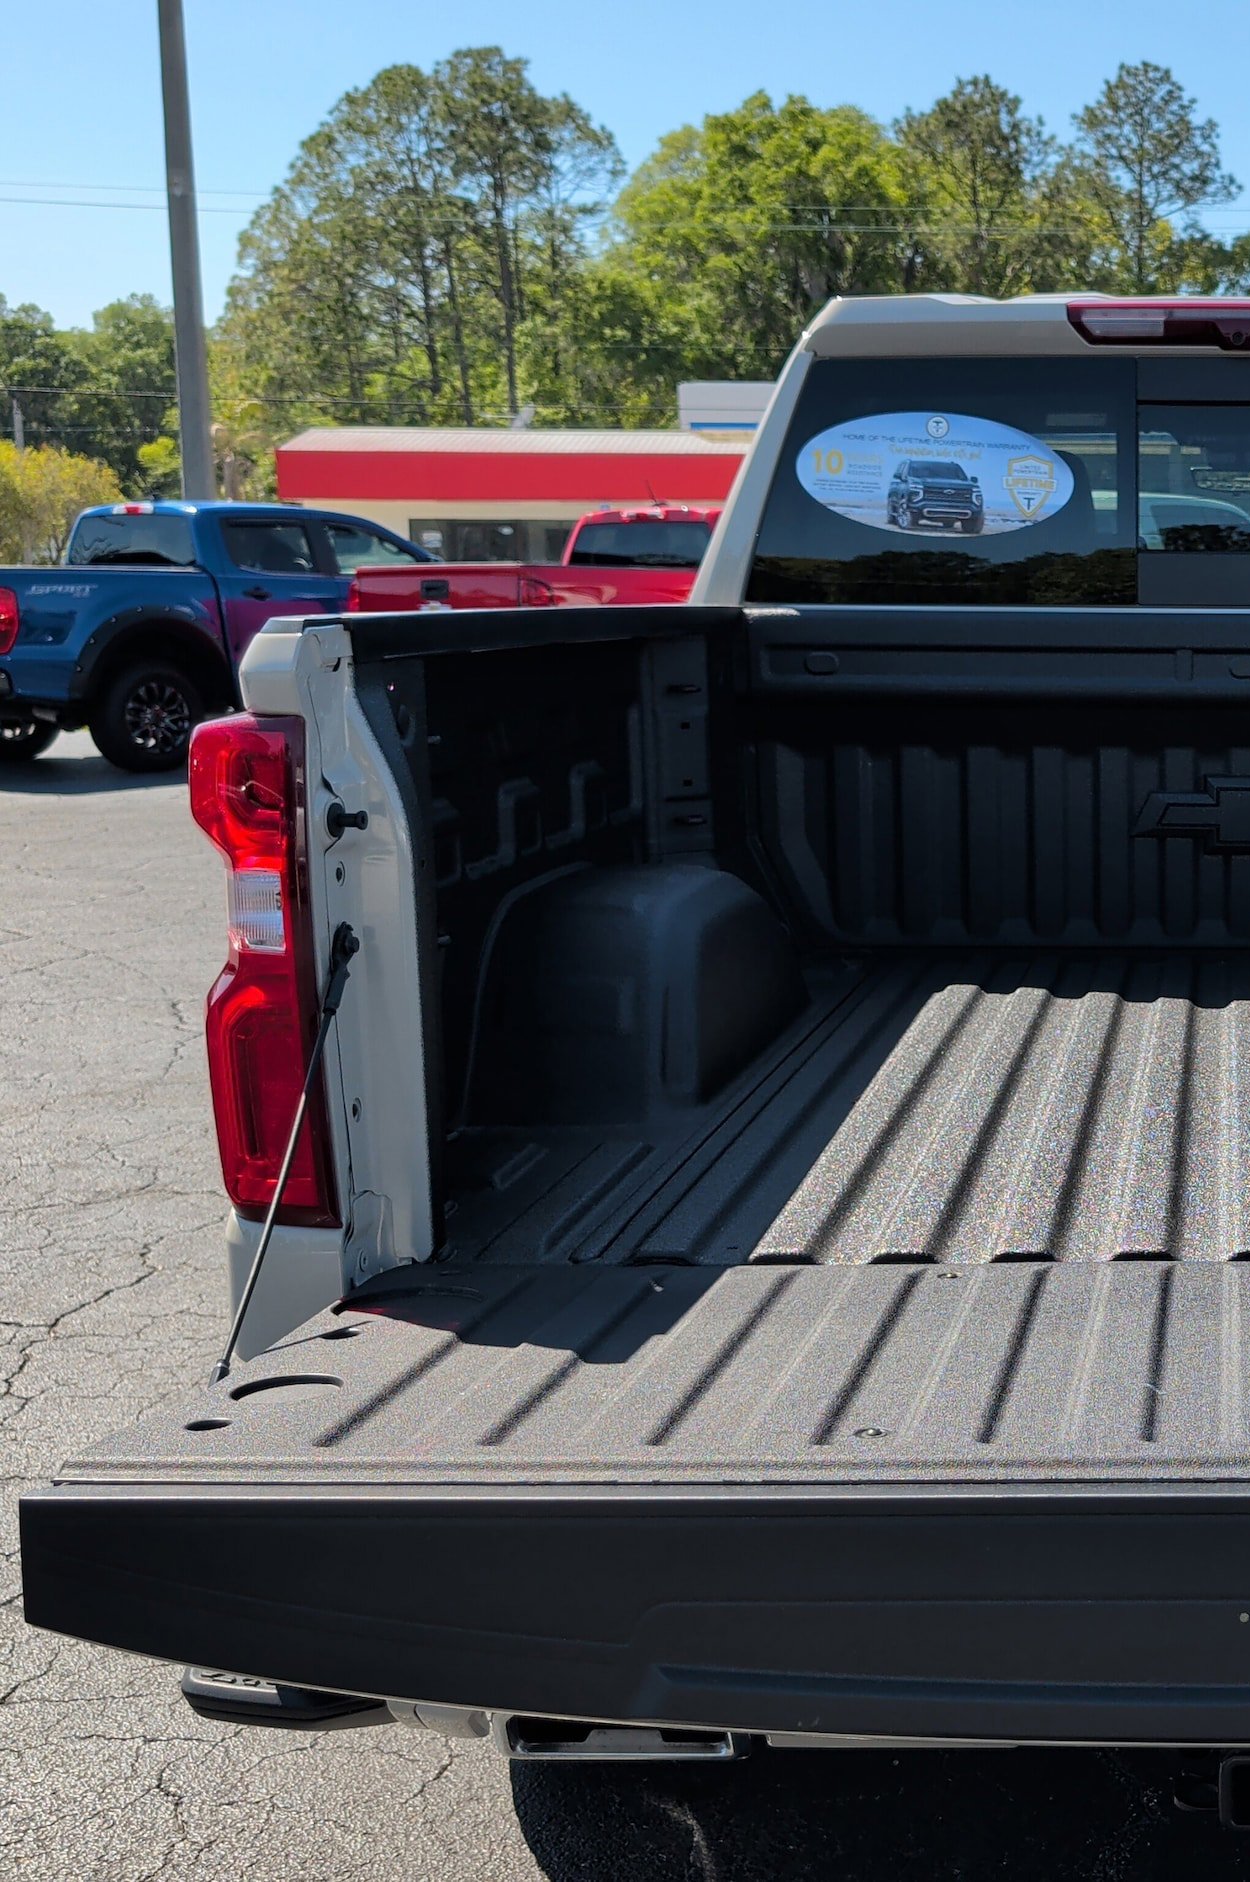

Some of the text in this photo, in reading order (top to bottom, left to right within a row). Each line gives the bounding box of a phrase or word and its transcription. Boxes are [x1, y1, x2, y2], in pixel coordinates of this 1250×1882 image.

[899, 437, 930, 445] LIFETIME
[987, 442, 1031, 450] WARRANTY
[812, 448, 844, 475] 10
[1005, 478, 1055, 490] LIFETIME
[1023, 497, 1036, 511] T
[26, 584, 99, 595] SPORT
